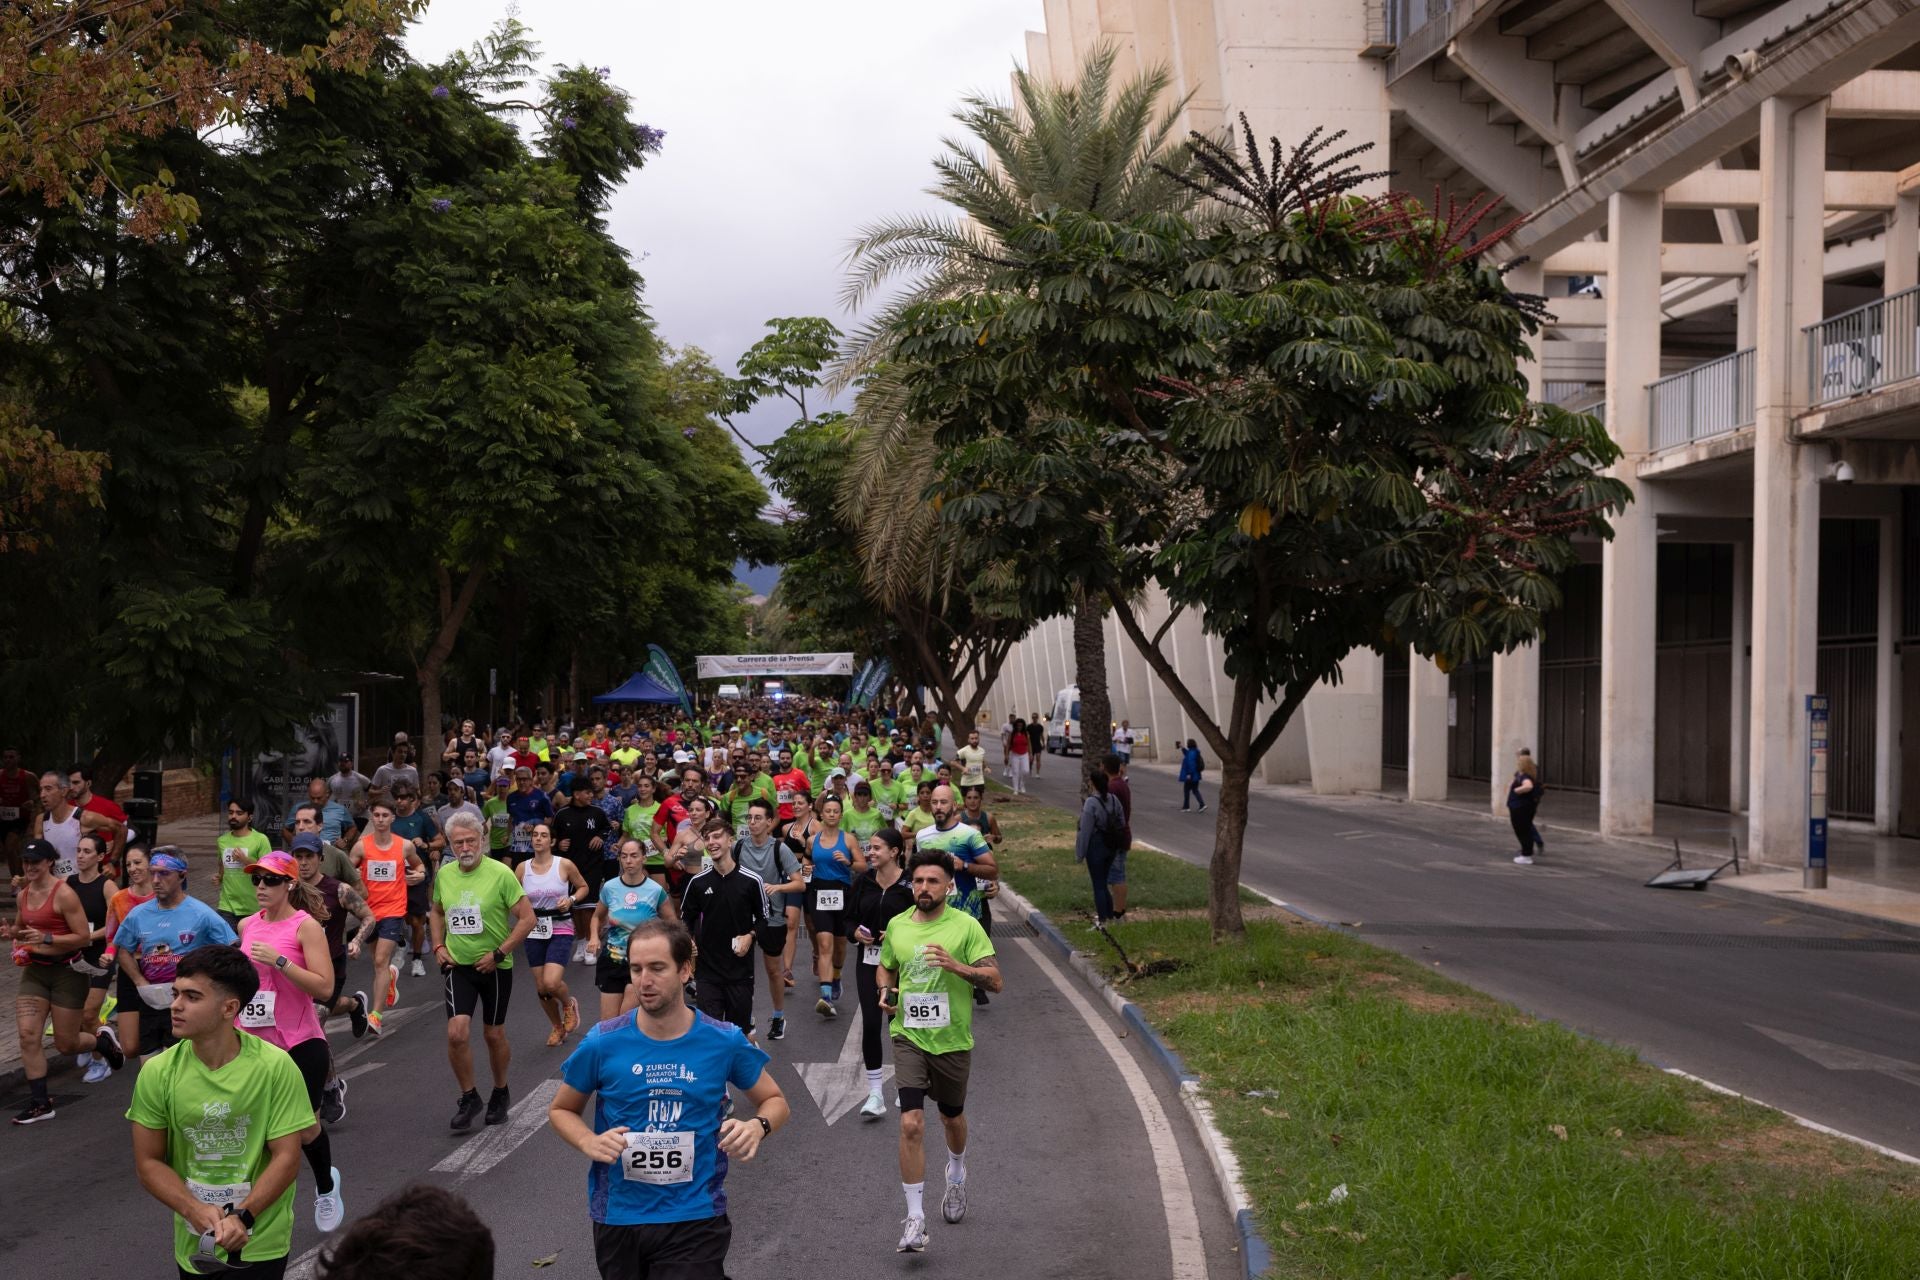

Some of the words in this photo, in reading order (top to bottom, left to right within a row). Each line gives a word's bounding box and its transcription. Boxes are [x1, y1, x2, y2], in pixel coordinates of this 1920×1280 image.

[1811, 698, 1828, 709] BUS
[374, 867, 388, 875] 26
[820, 897, 839, 905] 812
[452, 915, 476, 926] 216
[909, 1004, 941, 1018] 961
[645, 1063, 678, 1072] ZURICH
[645, 1070, 677, 1078] MARATÓN
[648, 1088, 666, 1097] 21K
[648, 1099, 683, 1122] RUN
[631, 1150, 683, 1169] 256
